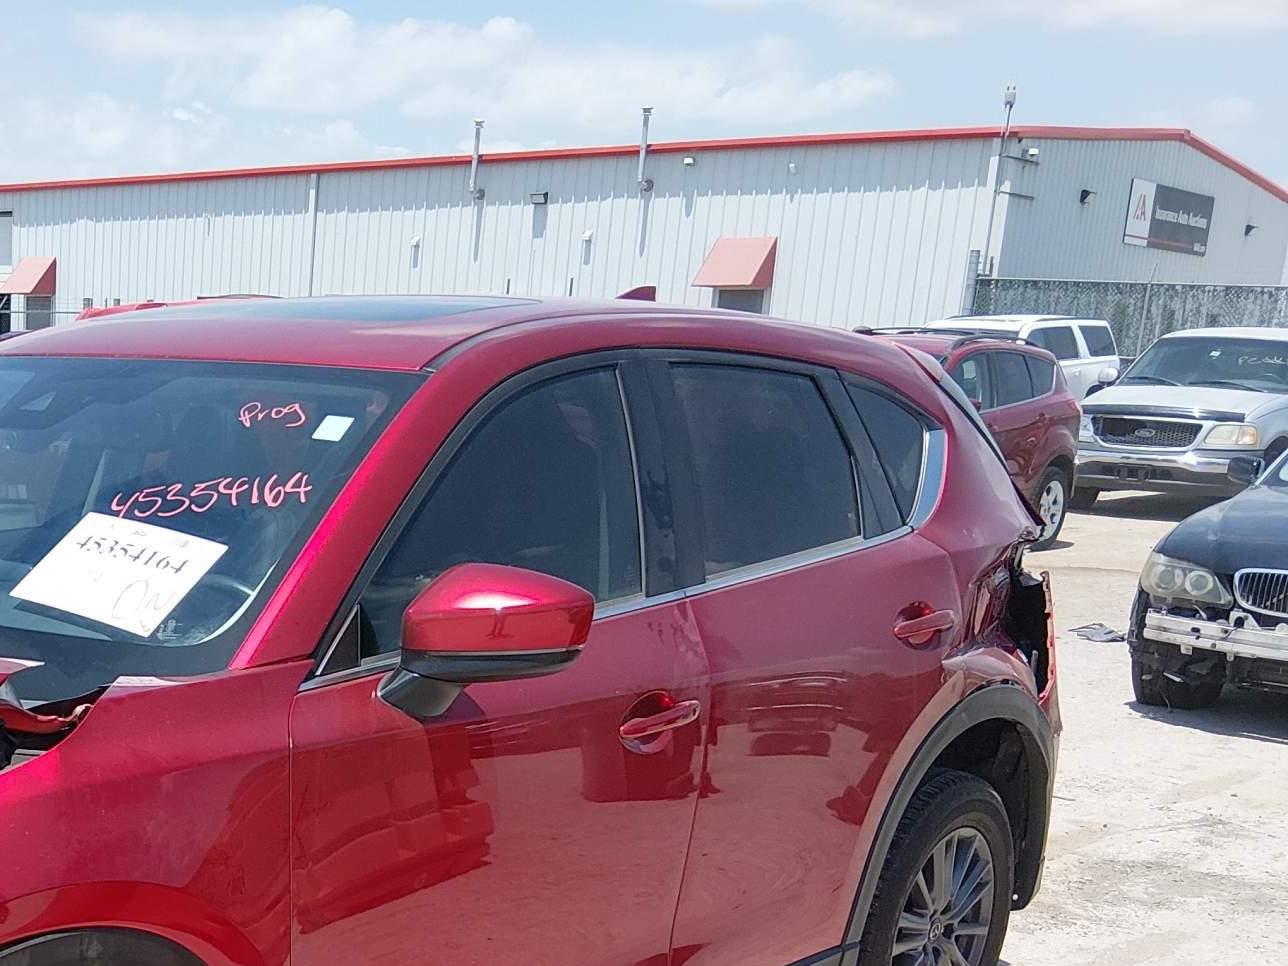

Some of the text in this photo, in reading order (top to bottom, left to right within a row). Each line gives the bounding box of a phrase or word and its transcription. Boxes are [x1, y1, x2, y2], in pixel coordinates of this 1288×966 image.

[238, 402, 306, 428] Prog
[110, 471, 313, 519] 45354164
[76, 535, 189, 574] 45354164
